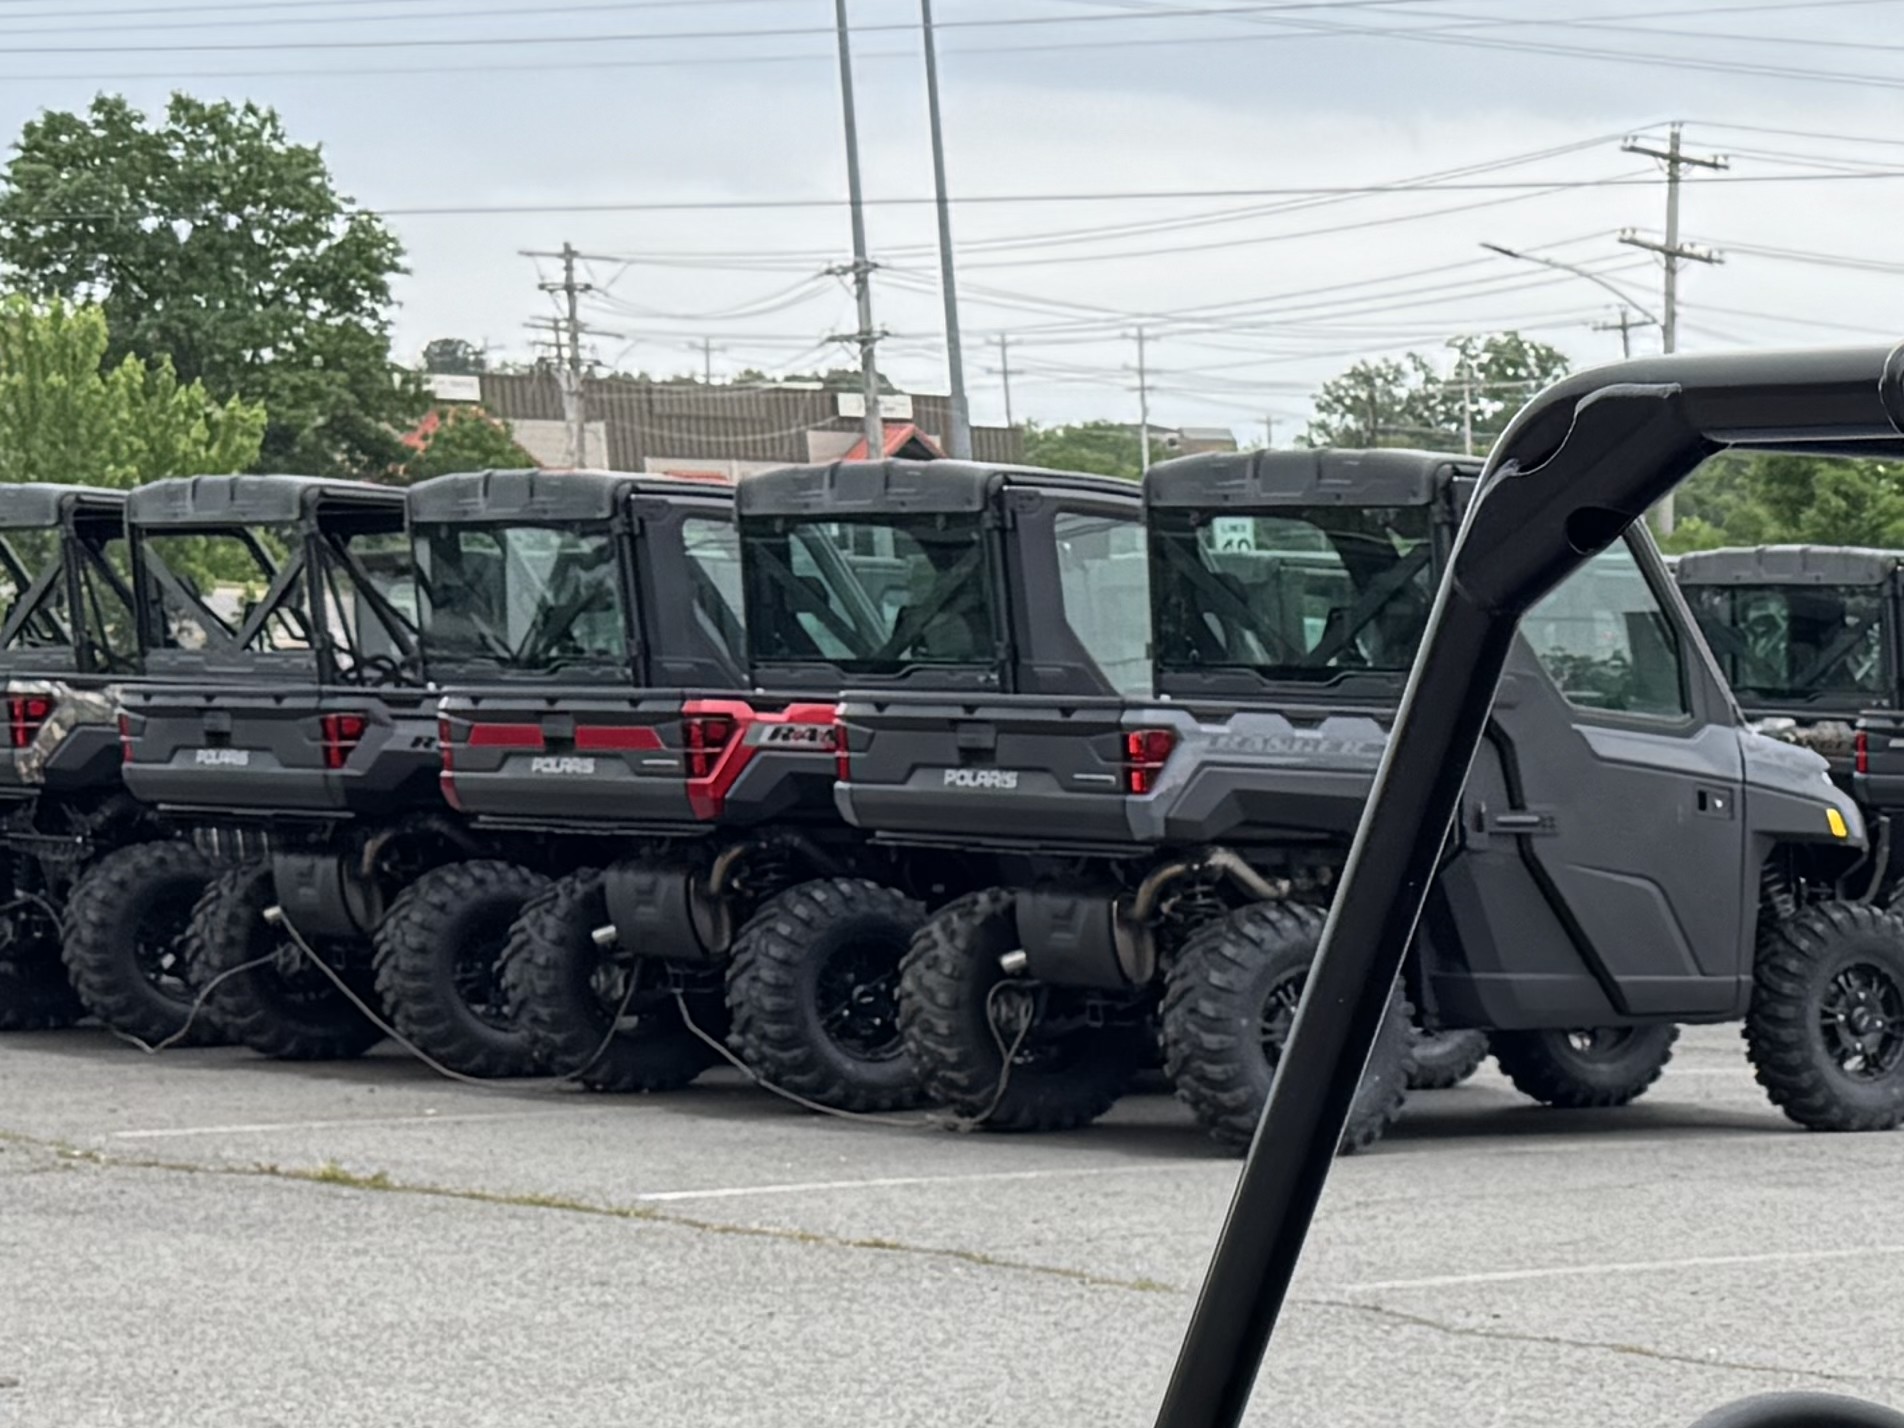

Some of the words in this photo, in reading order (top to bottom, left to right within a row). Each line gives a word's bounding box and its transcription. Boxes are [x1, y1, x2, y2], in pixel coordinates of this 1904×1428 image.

[195, 749, 250, 766] POLARIS
[532, 756, 595, 774] POLARIS
[944, 769, 1018, 788] POLARIS
